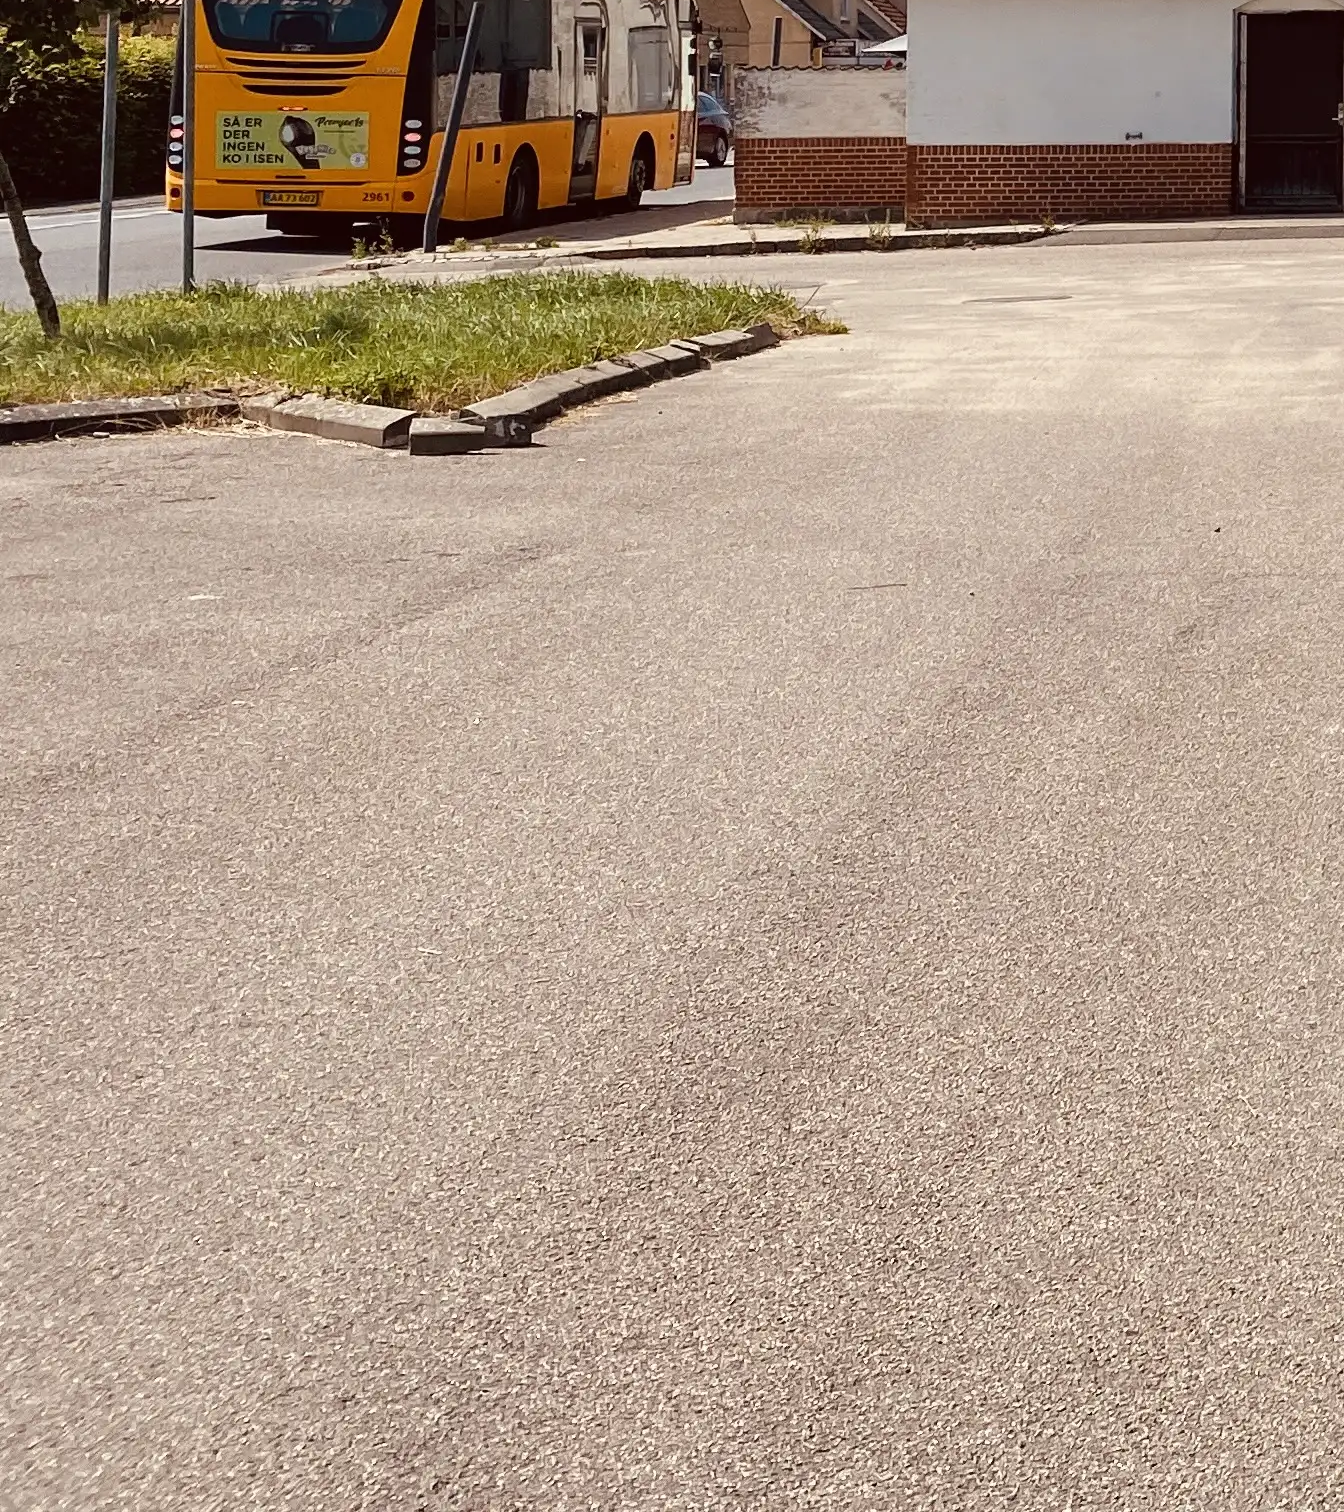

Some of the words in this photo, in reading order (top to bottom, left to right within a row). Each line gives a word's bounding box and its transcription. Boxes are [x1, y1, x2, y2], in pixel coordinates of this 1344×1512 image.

[223, 116, 240, 127] SÅ
[245, 118, 263, 127] ER
[223, 129, 250, 139] DER
[222, 142, 265, 151] INGEN
[223, 154, 241, 163] KO
[254, 154, 284, 163] ISEN
[362, 192, 390, 202] 2961
